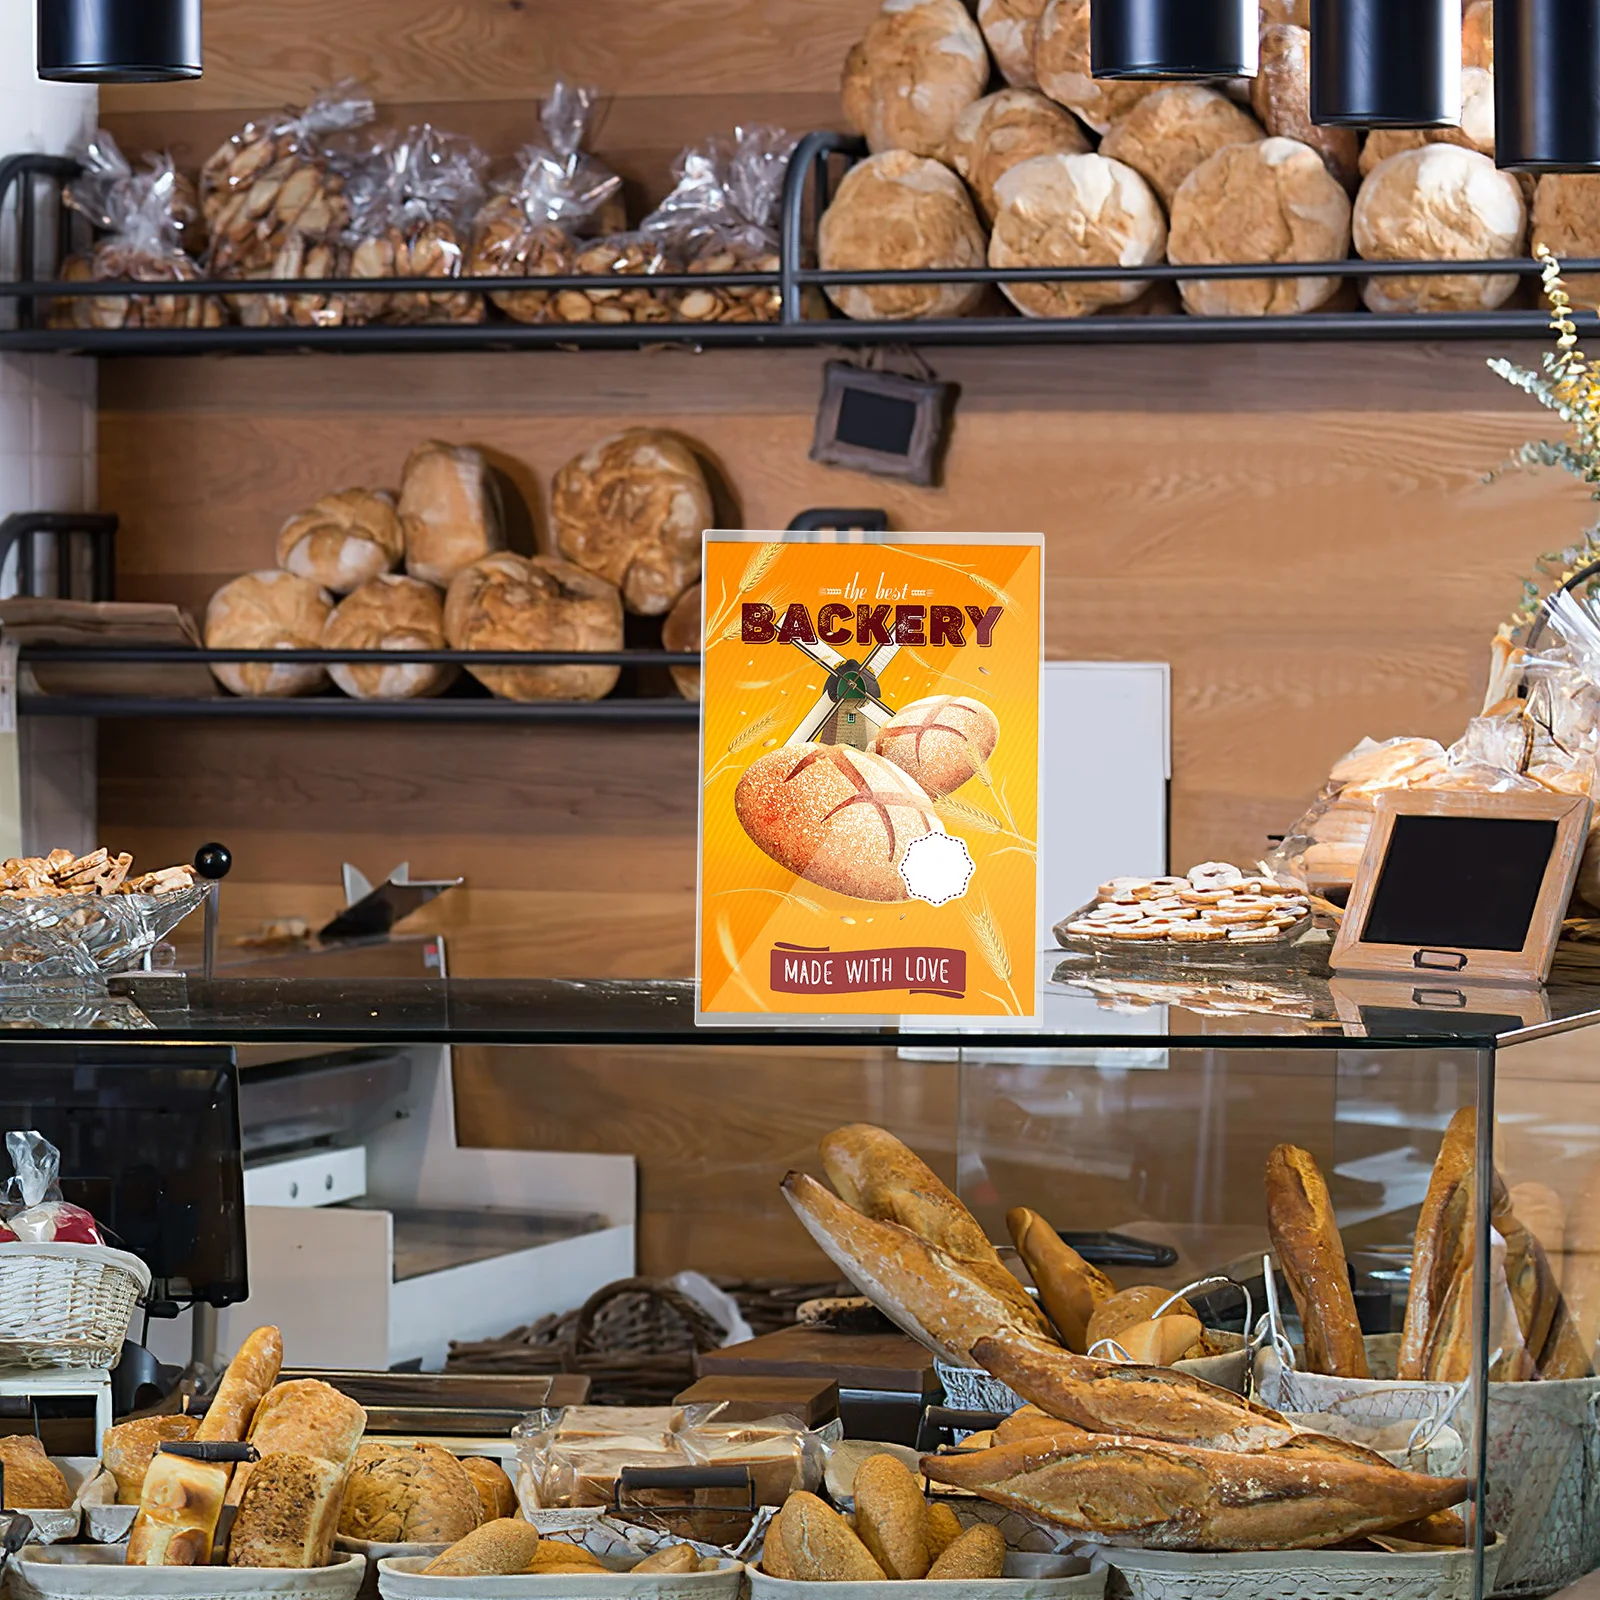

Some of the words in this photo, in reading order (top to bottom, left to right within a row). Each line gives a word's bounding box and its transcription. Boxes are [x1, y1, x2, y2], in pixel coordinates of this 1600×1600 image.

[843, 572, 867, 603] the
[875, 572, 909, 600] best
[741, 603, 1004, 647] BACKERY
[784, 958, 833, 985] MADE
[845, 957, 893, 984] WITH
[905, 956, 950, 984] LOVE
